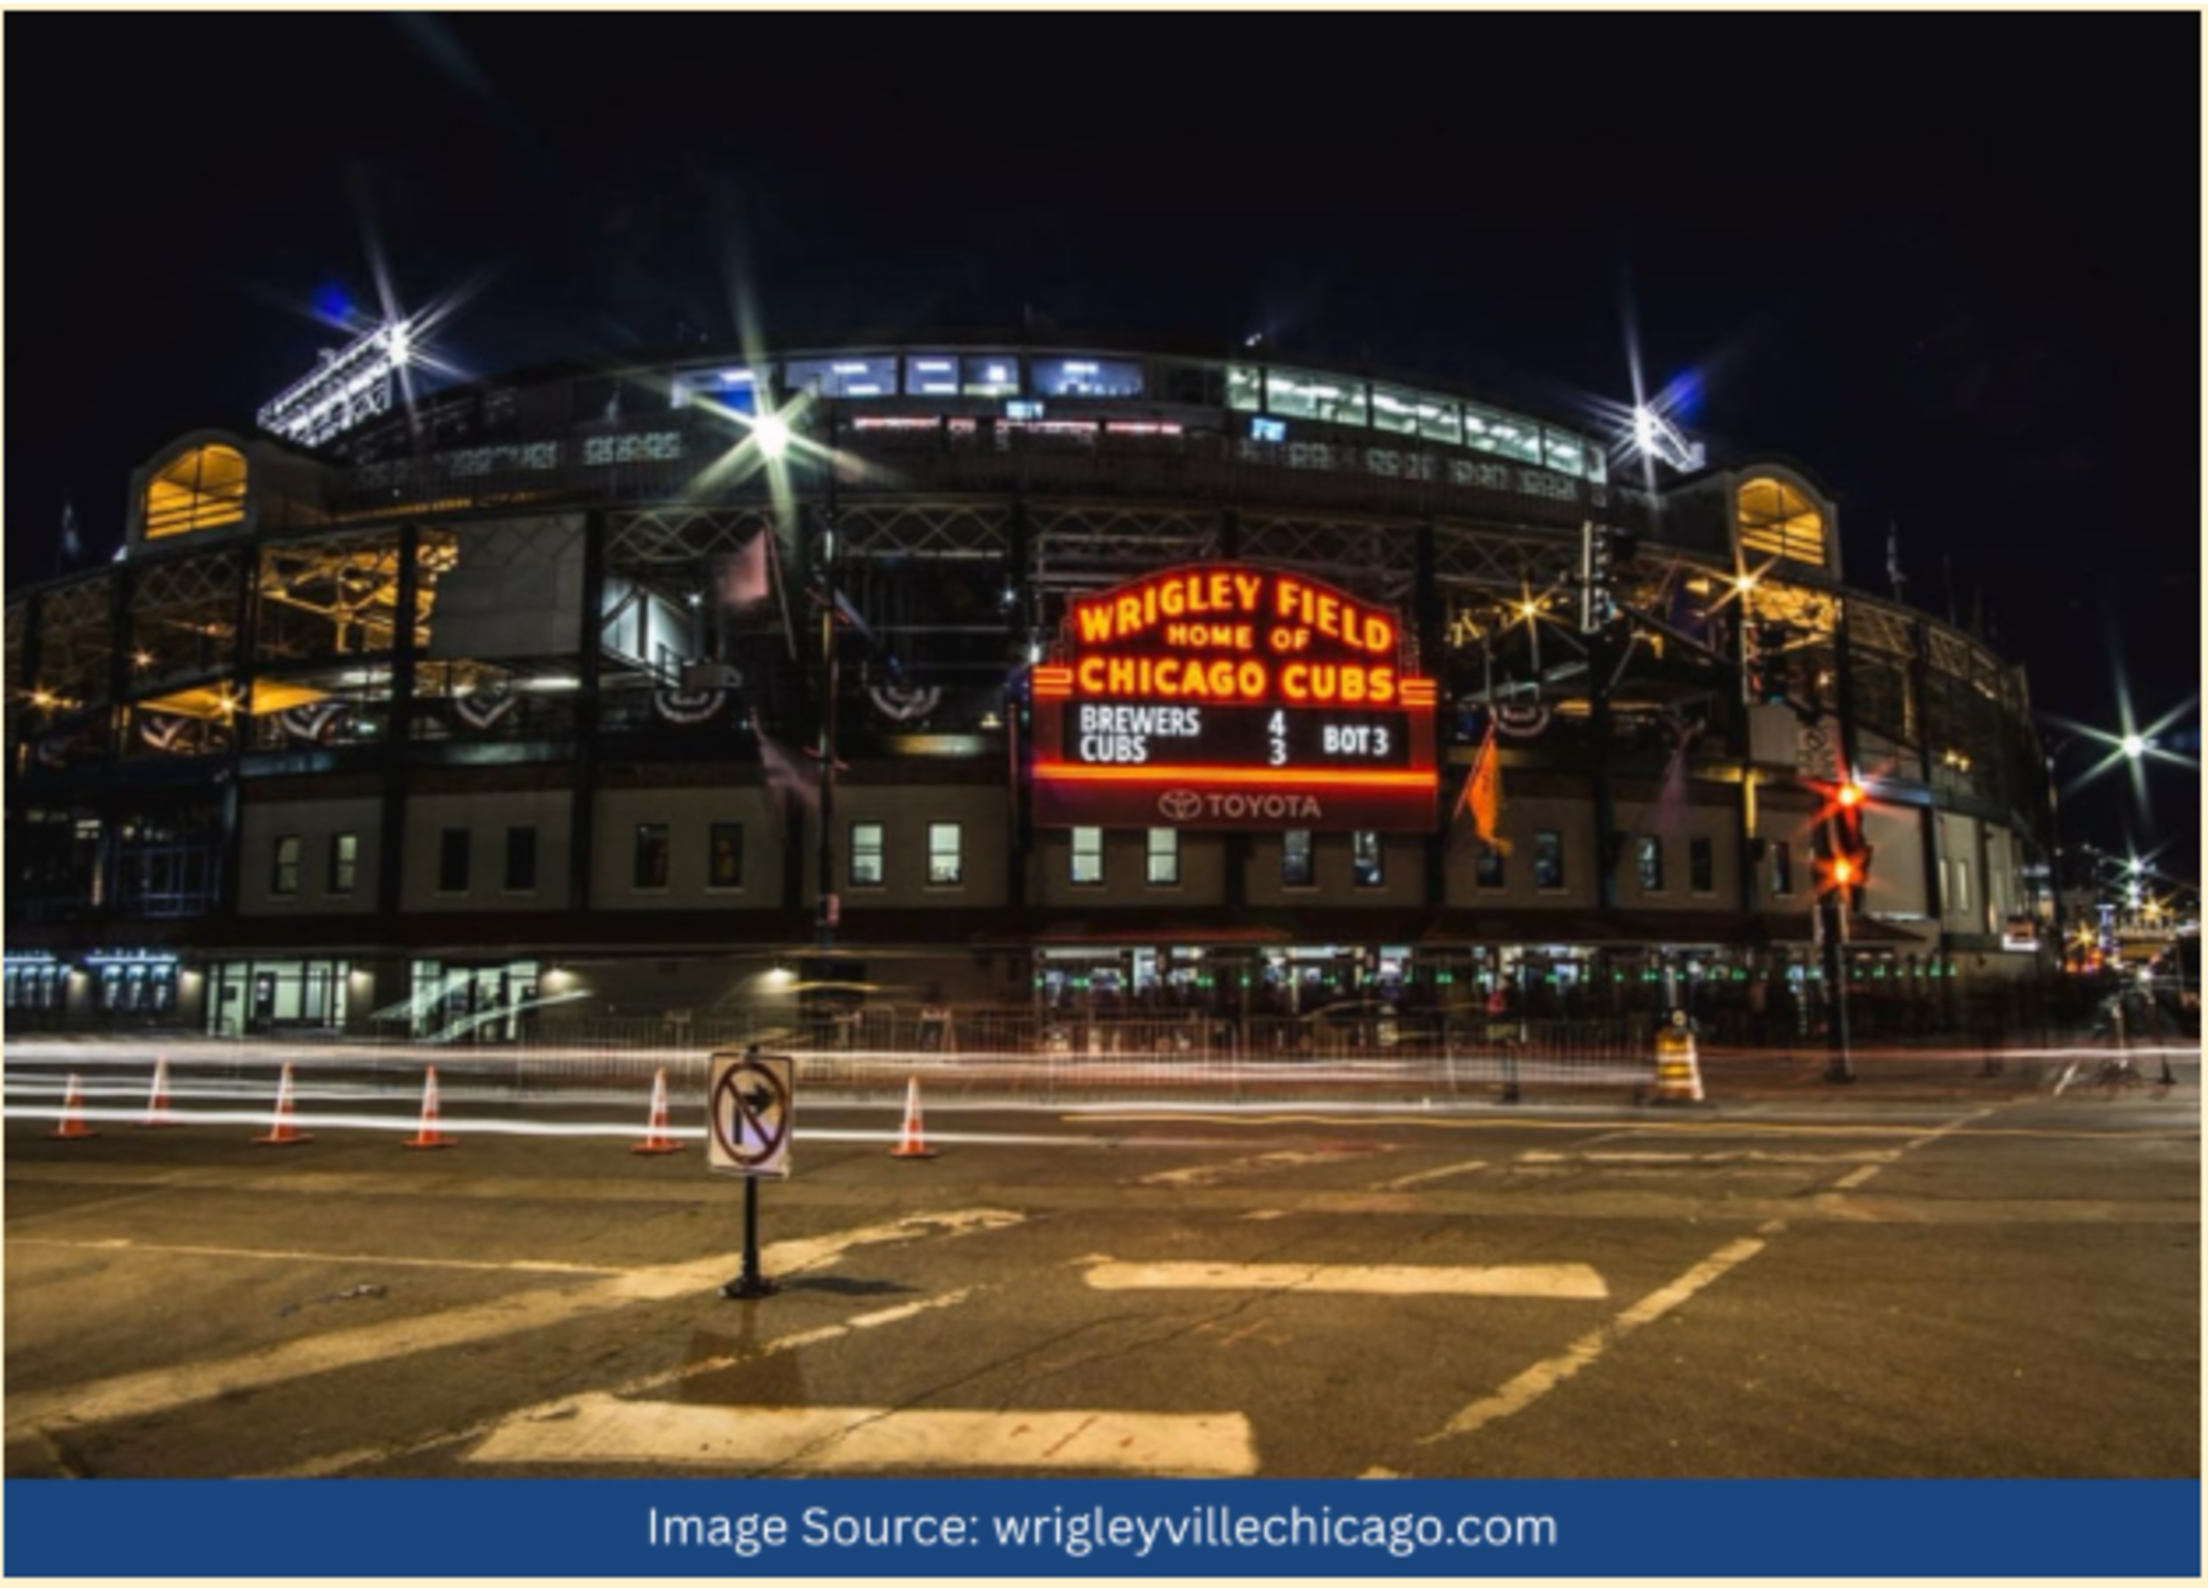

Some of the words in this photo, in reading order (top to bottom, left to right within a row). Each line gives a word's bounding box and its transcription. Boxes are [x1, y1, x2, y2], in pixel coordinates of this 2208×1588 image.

[1079, 574, 1260, 642] WRIGLEY
[1277, 580, 1392, 652] FIELD
[1167, 624, 1251, 648] HOME
[1270, 627, 1309, 650] OF
[1078, 657, 1267, 697] CHICAGO
[1281, 664, 1394, 701] CUBS
[1079, 704, 1201, 737] BREWERS
[1267, 709, 1287, 738] 4
[1079, 736, 1148, 764] CUBS
[1269, 739, 1288, 767] 3
[1206, 794, 1322, 819] TOYOTA
